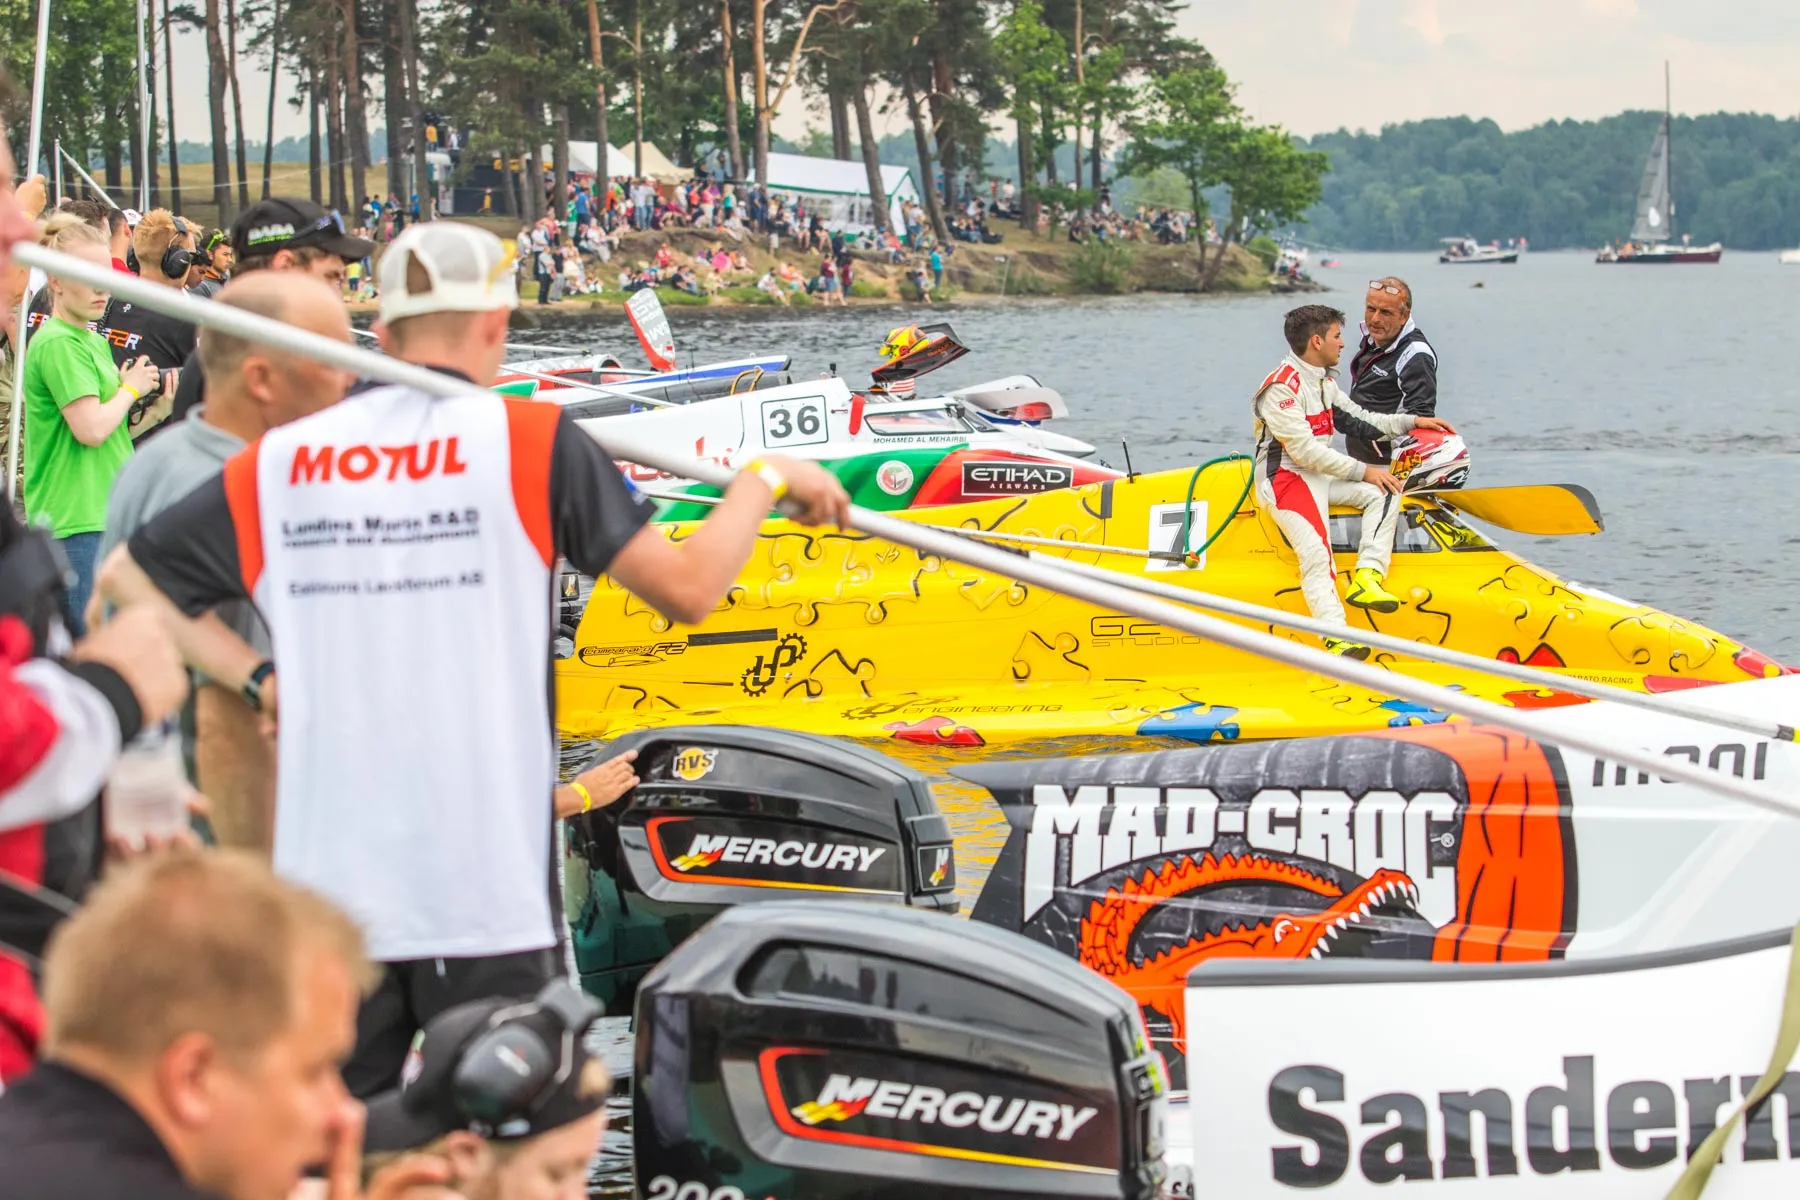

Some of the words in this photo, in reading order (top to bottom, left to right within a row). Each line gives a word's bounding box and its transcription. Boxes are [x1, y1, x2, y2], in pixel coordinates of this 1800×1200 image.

[1279, 399, 1295, 409] OMP
[769, 405, 820, 438] 36
[289, 436, 467, 487] MOTUL
[970, 467, 1066, 483] ETIHAD
[1160, 508, 1198, 568] 7
[650, 641, 688, 656] F2
[1092, 636, 1201, 648] STUDIO
[1601, 676, 1634, 685] RACING
[675, 753, 713, 771] RVS
[687, 834, 886, 872] MERCURY
[816, 1073, 1098, 1141] MERCURY
